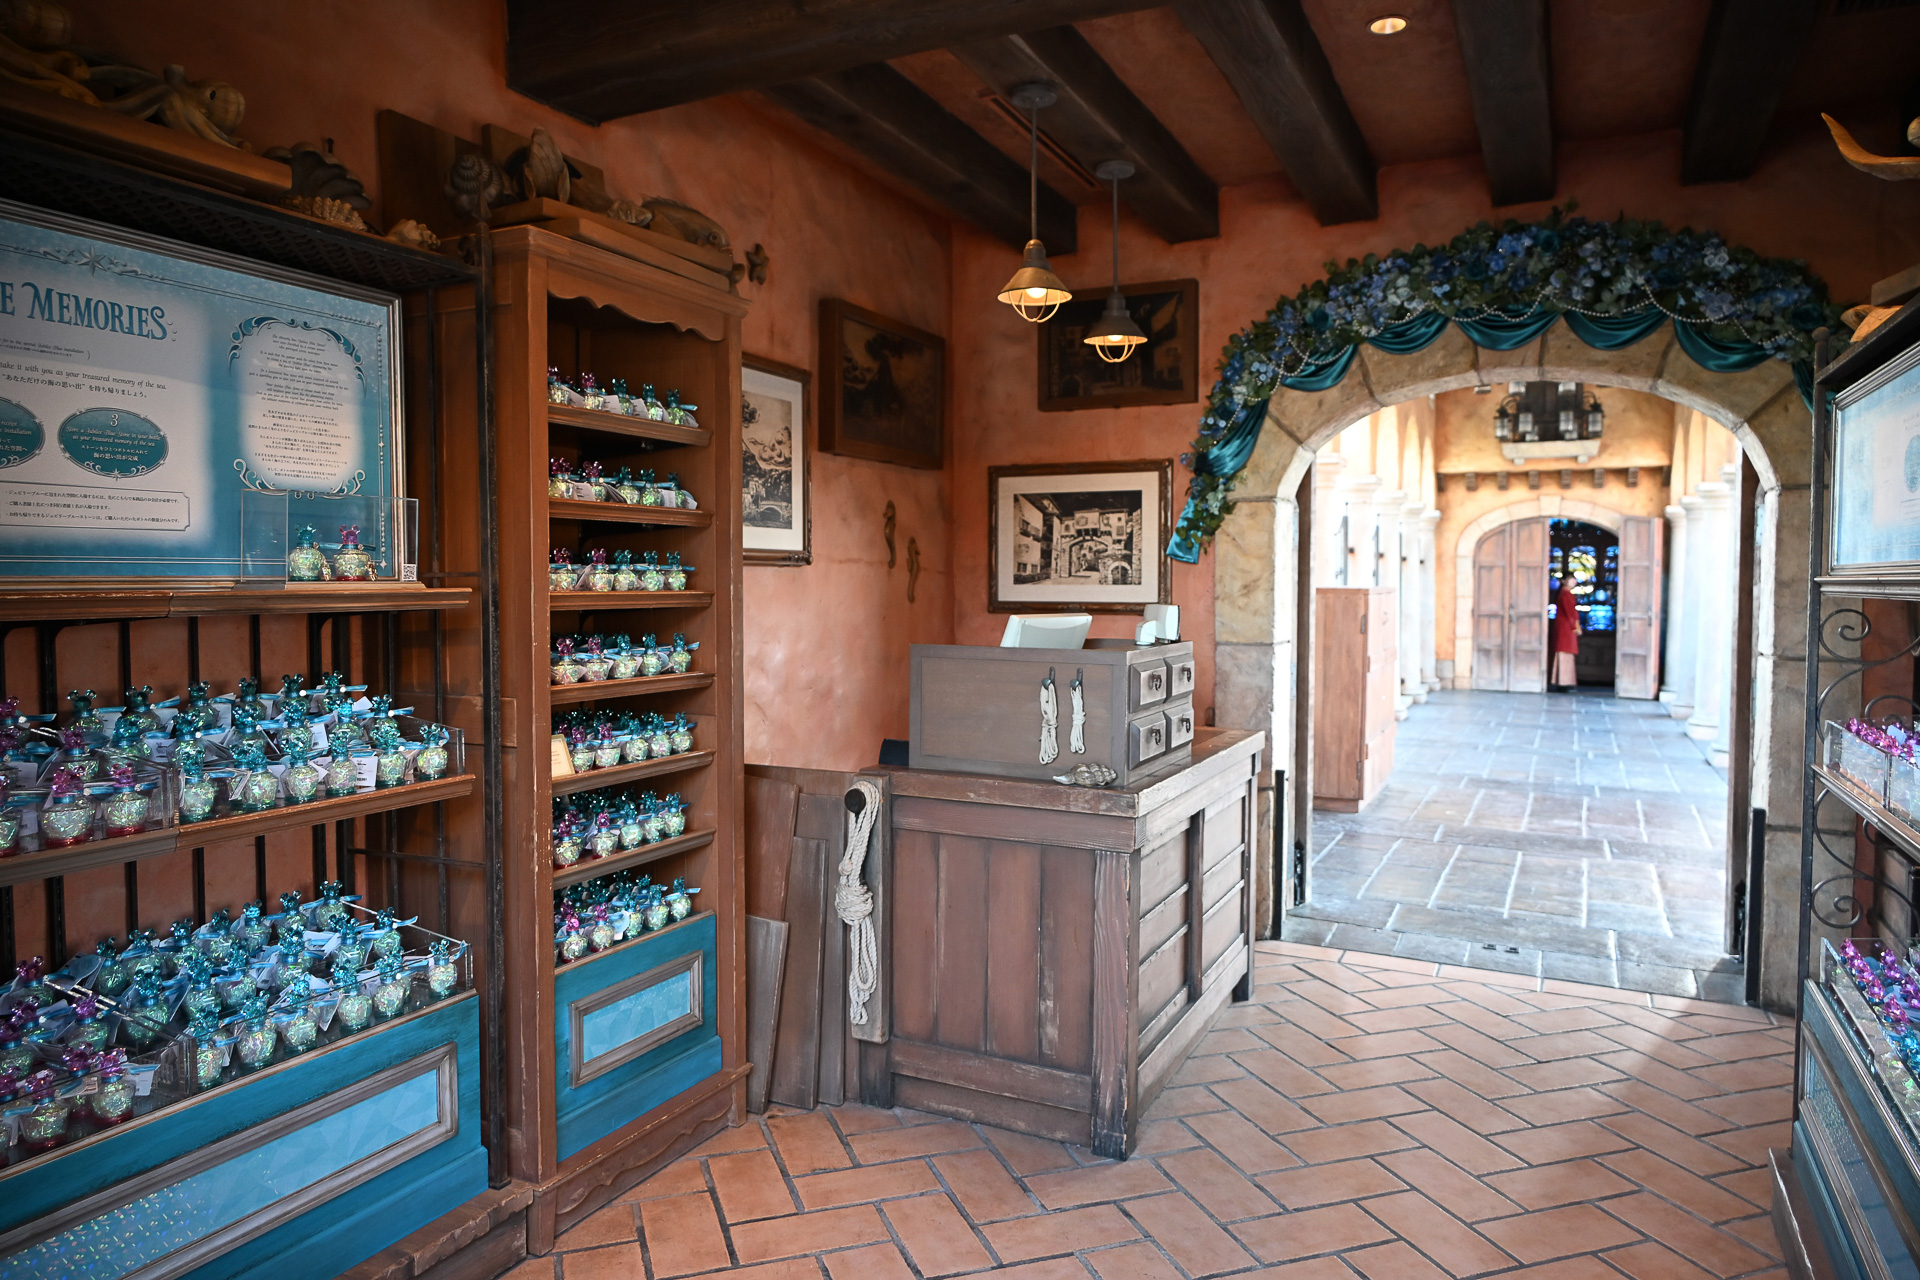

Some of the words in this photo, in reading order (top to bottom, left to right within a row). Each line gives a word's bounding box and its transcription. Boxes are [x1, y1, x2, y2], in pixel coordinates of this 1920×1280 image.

[21, 282, 168, 340] MEMORIES
[25, 365, 39, 373] with
[82, 373, 110, 382] treasured
[112, 378, 136, 388] memory
[137, 380, 145, 388] of
[110, 413, 119, 427] 3
